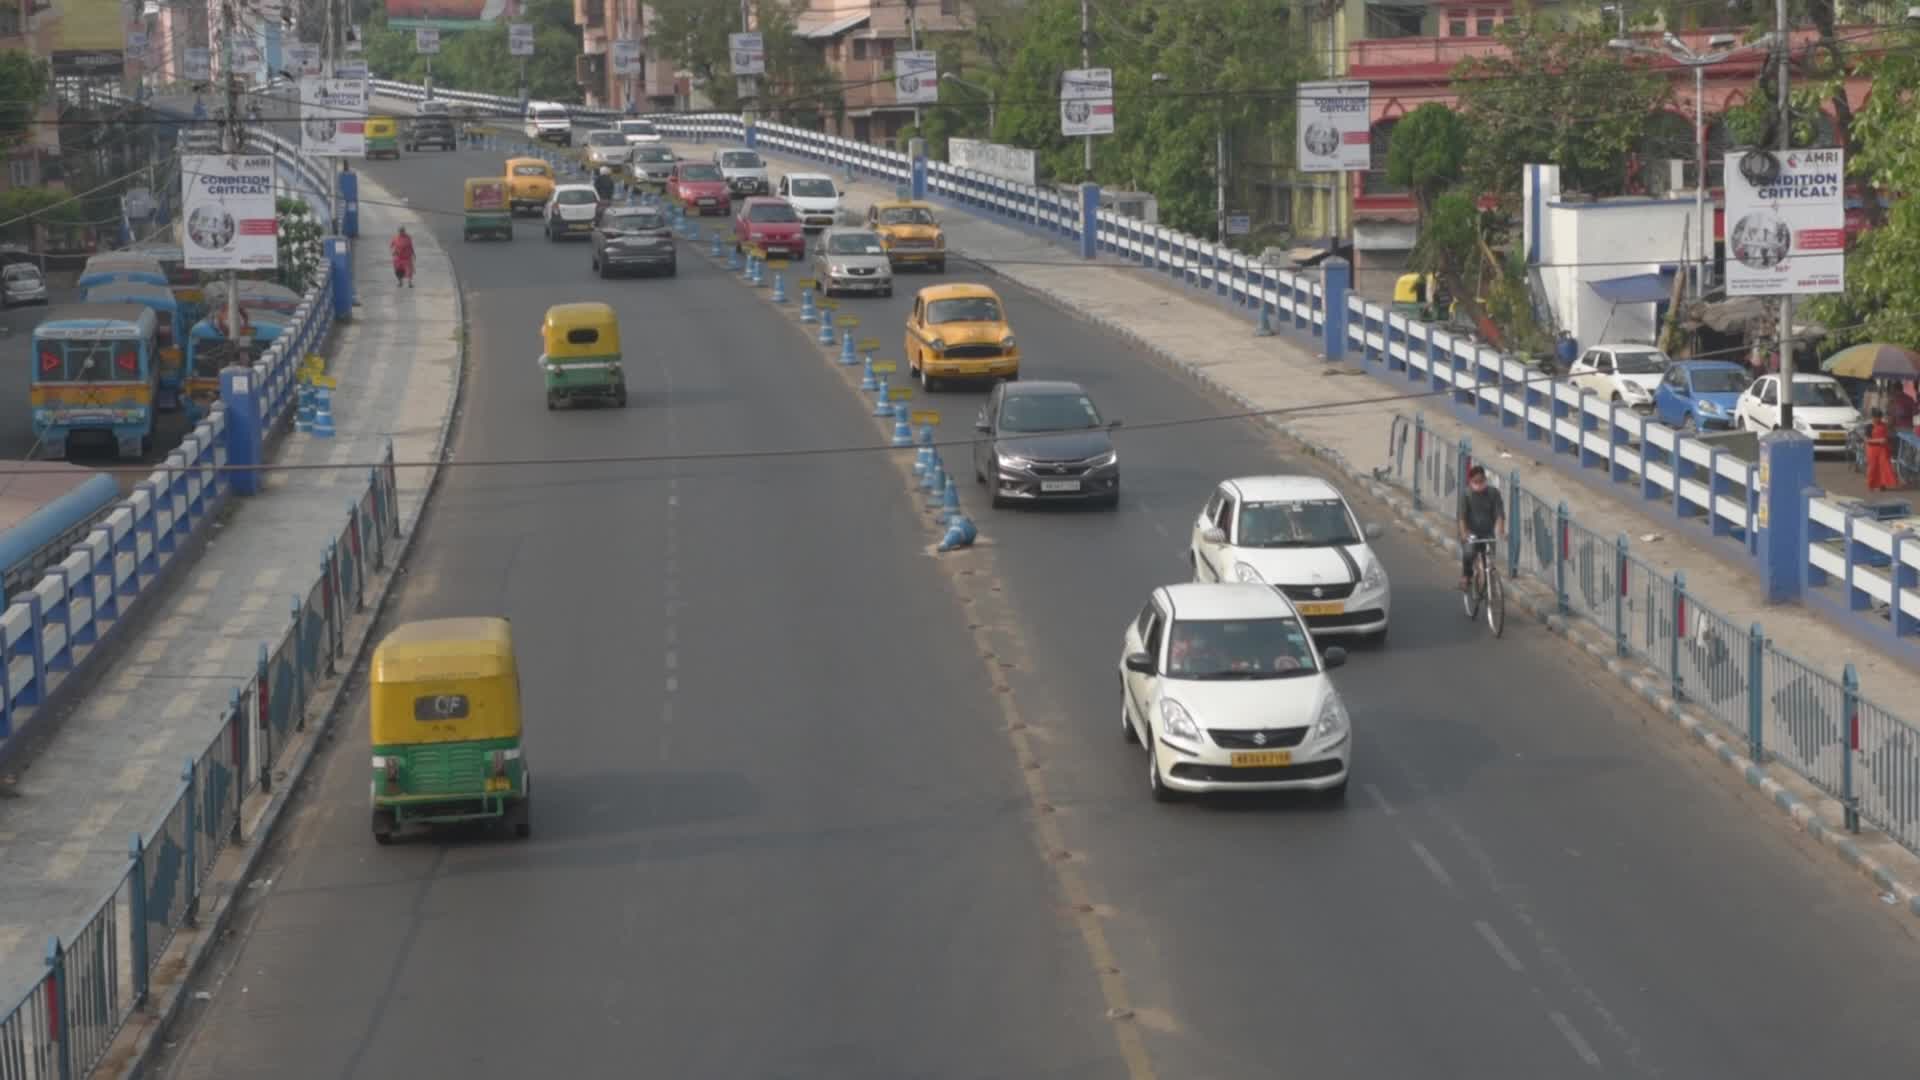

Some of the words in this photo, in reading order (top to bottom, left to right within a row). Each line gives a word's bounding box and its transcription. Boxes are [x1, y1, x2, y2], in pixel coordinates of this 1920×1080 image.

[1804, 151, 1839, 163] AMRI
[244, 159, 271, 168] AMRI
[200, 175, 270, 185] CONDITION
[1758, 186, 1838, 199] CRITICAL?
